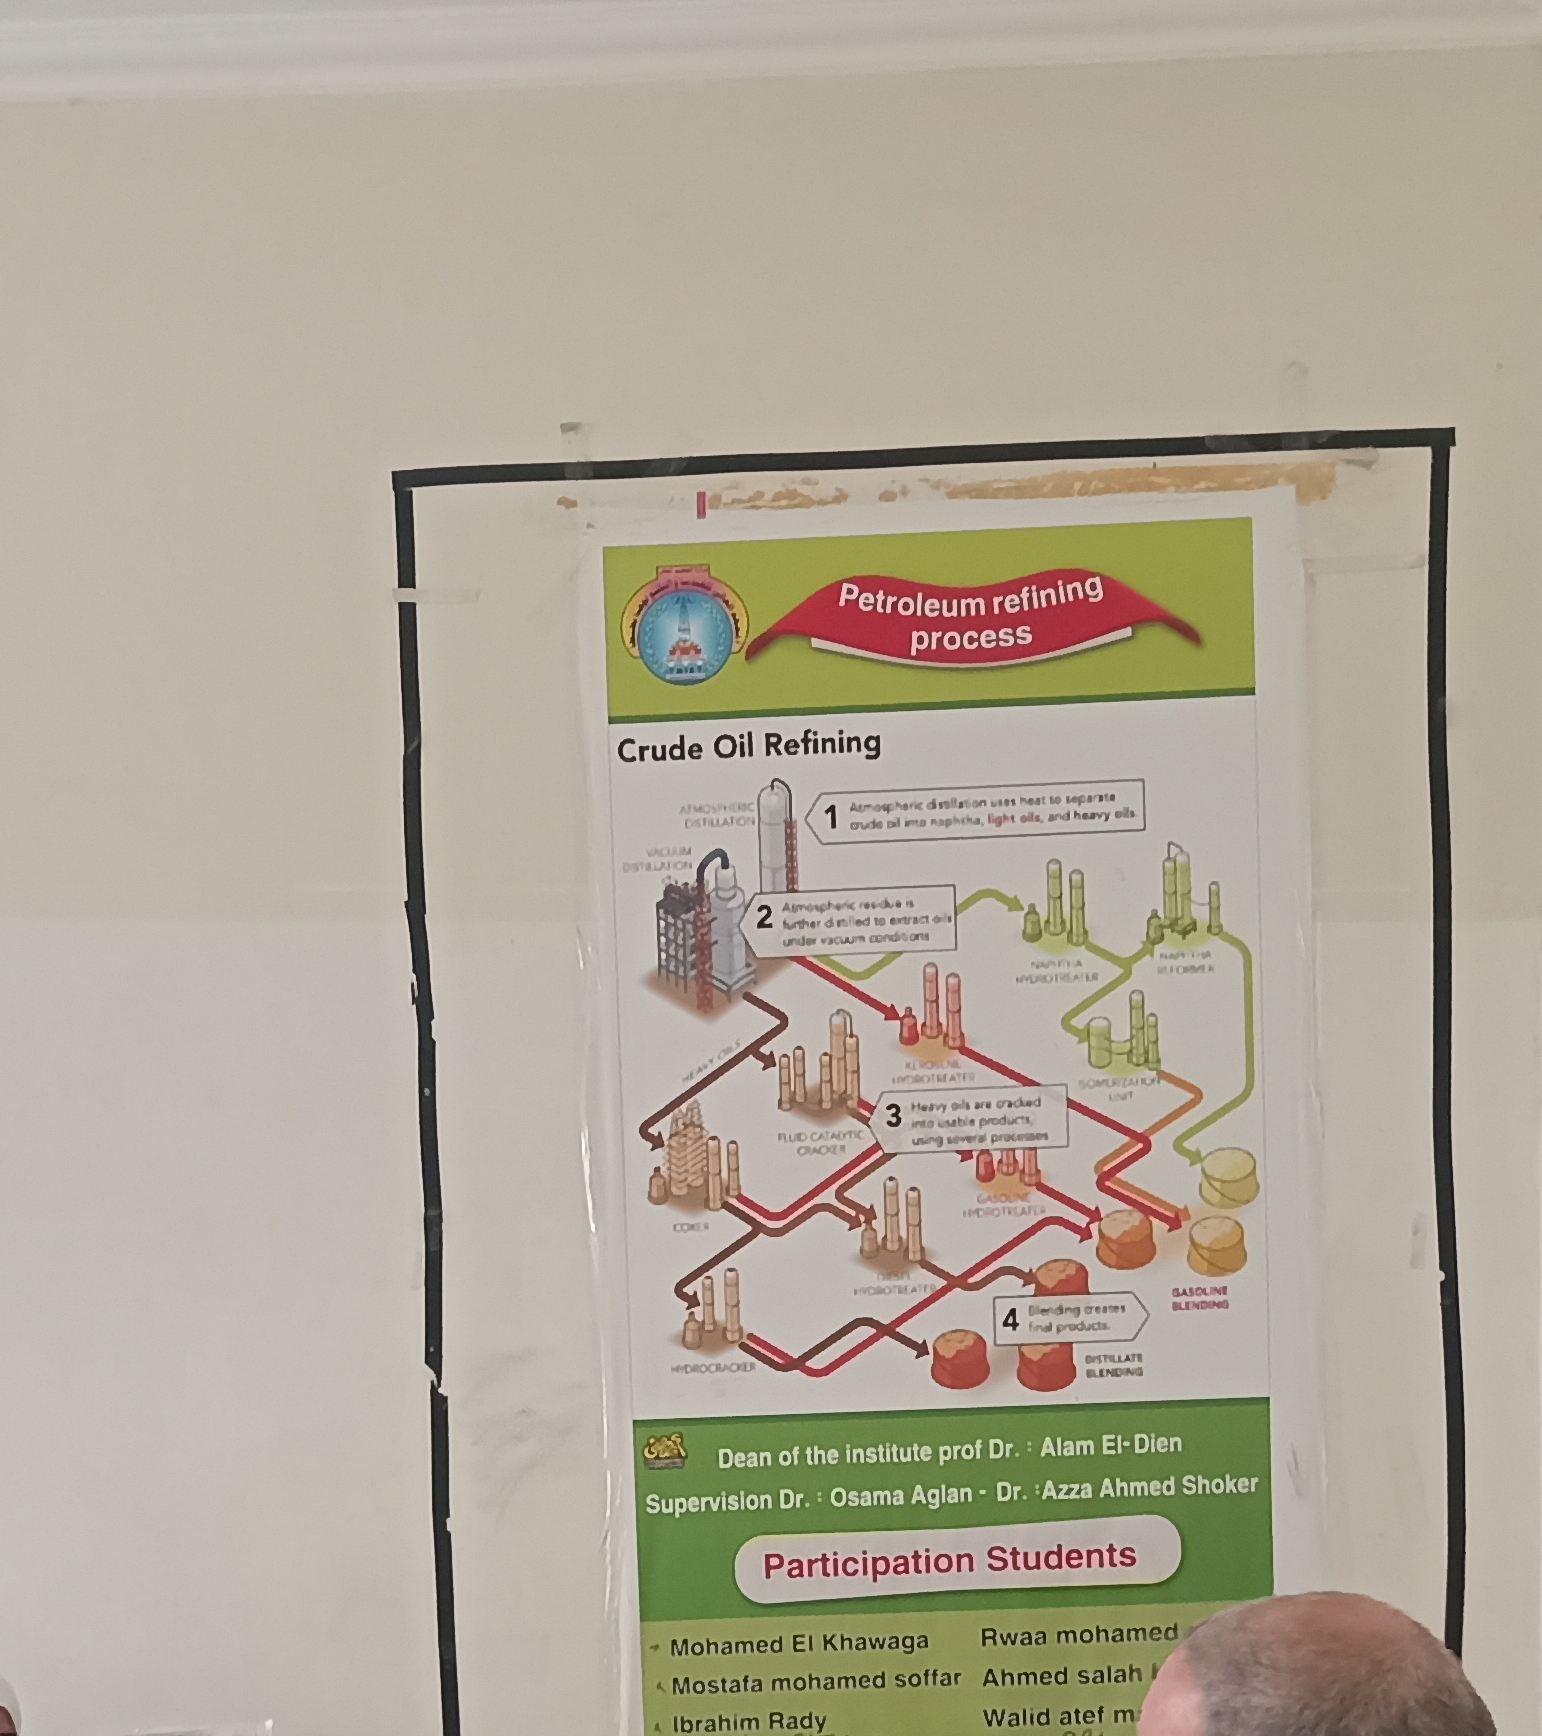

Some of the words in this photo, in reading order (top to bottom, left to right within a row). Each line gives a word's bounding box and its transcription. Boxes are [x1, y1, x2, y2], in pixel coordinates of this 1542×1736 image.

[838, 582, 986, 618] Petroleum
[992, 575, 1104, 615] refining
[910, 624, 1033, 656] process
[617, 734, 704, 763] Crude
[713, 731, 754, 759] Oil
[764, 728, 881, 760] Refining
[684, 815, 756, 829] DISTILLATION
[824, 804, 837, 829] 1
[987, 812, 1016, 828] light
[1073, 808, 1111, 823] heavy
[756, 904, 773, 929] 2
[885, 1103, 902, 1128] 3
[911, 1101, 947, 1114] Heavy
[911, 1133, 944, 1148] using
[1171, 1285, 1228, 1298] GASOLINE
[1028, 1303, 1081, 1318] Blending
[1171, 1299, 1230, 1312] BLENDING
[1001, 1307, 1020, 1332] 4
[1084, 1352, 1144, 1365] DISTILLATE
[1085, 1366, 1144, 1379] BLENDING
[718, 1448, 773, 1469] Dean
[778, 1446, 800, 1466] of
[805, 1445, 839, 1465] the
[846, 1443, 933, 1465] institute
[938, 1439, 983, 1466] prof
[1040, 1436, 1095, 1458] Alam
[645, 1490, 773, 1518] Supervision
[829, 1487, 905, 1508] Osama
[911, 1484, 973, 1510] Aglan
[1099, 1475, 1176, 1499] Ahmed
[1181, 1473, 1259, 1495] Shoker
[764, 1547, 975, 1583] Participation
[987, 1542, 1137, 1572] Students
[670, 1634, 783, 1657] Mohamed
[792, 1634, 814, 1653] El
[822, 1633, 929, 1655] Khawaga
[981, 1627, 1047, 1647] Rwaa
[1056, 1623, 1179, 1644] mohamed
[672, 1675, 763, 1696] Mostafa
[771, 1671, 886, 1692] mohamed
[894, 1668, 962, 1688] soffar
[982, 1666, 1069, 1687] Ahmed
[1077, 1663, 1143, 1685] salah
[672, 1714, 760, 1734] Ibrahim
[769, 1711, 827, 1734] Rady
[982, 1707, 1051, 1728] Walid
[1059, 1705, 1106, 1726] atef
